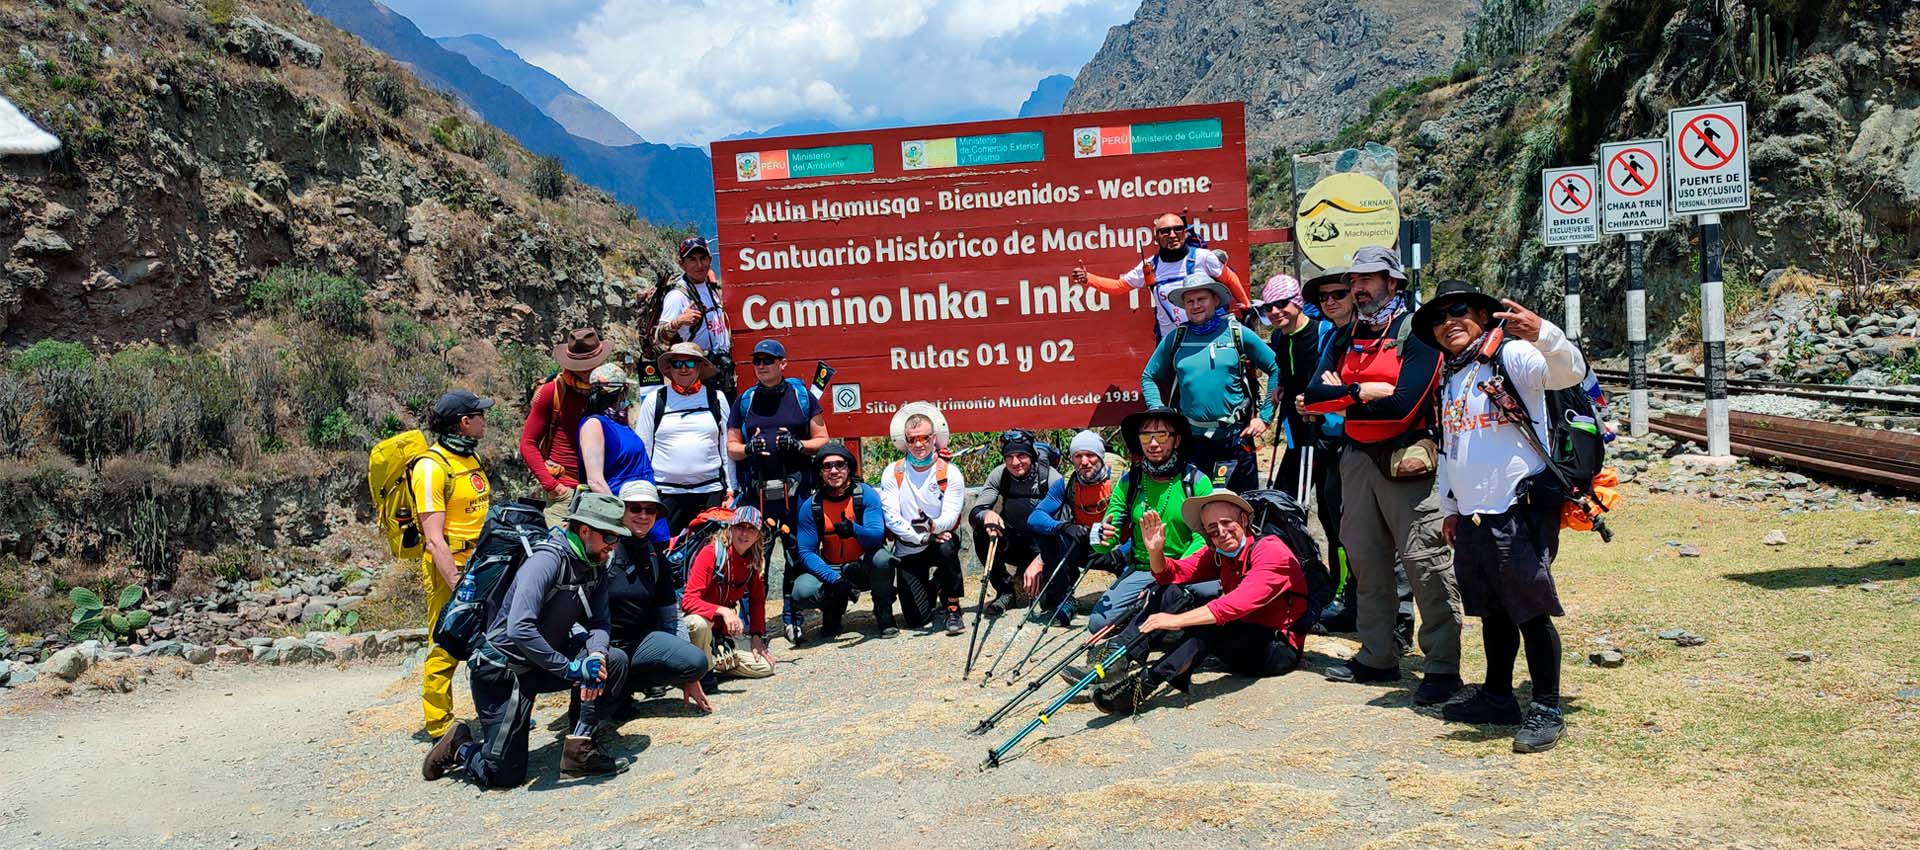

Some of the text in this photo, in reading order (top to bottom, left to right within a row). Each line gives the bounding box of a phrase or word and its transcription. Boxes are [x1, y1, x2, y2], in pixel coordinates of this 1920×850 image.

[959, 136, 997, 146] Ministerio
[1132, 130, 1220, 144] Ministerio de Cultura
[960, 142, 1040, 154] de Comercio Exterior
[792, 151, 831, 161] Ministerio
[961, 154, 1000, 163] y Turismo
[793, 160, 845, 172] del Ambiente
[1680, 173, 1740, 186] PUENTE DE
[1678, 185, 1743, 198] USO EXCLUSIVO
[750, 199, 807, 224] Allin
[812, 197, 920, 219] Hamusqa
[938, 183, 1080, 211] Bienvenidos
[1098, 175, 1211, 200] Welcome
[1359, 199, 1393, 208] SERNANP
[1607, 199, 1662, 211] CHAKA TREN
[1678, 196, 1743, 208] PERSONAL FERROVIARIO
[1622, 210, 1647, 219] AMA
[1553, 217, 1590, 226] BRIDGE
[1607, 218, 1663, 229] CHIMPAYCHU
[1549, 224, 1595, 235] EXCLUSIVE USE
[738, 217, 1229, 271] Santuario Histórico de Machuphu
[742, 287, 893, 331] Camino
[900, 282, 988, 322] Inka
[890, 339, 1076, 373] Rutas 01 y 02
[865, 401, 897, 414] Sitio
[920, 396, 996, 411] trimonio
[999, 393, 1057, 408] Mundial
[1060, 392, 1101, 406] desde
[1104, 390, 1139, 403] 1983
